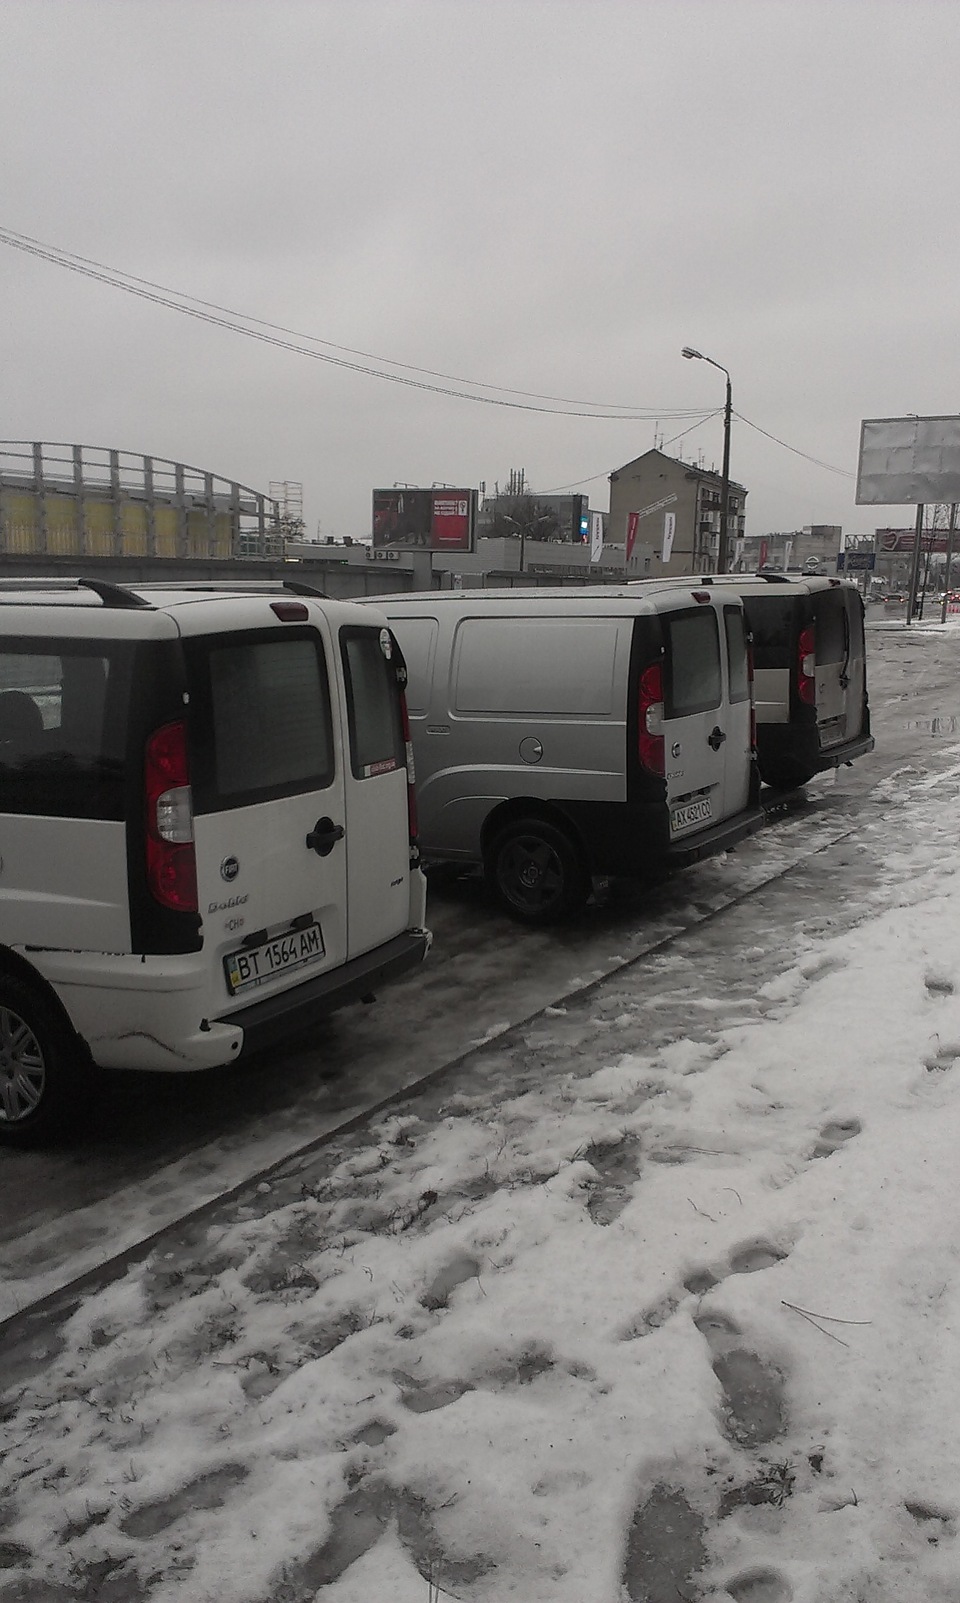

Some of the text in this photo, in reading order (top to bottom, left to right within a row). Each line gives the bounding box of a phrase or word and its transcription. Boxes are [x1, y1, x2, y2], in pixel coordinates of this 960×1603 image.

[677, 810, 688, 826] AX
[237, 930, 319, 980] BT 1564 AM
